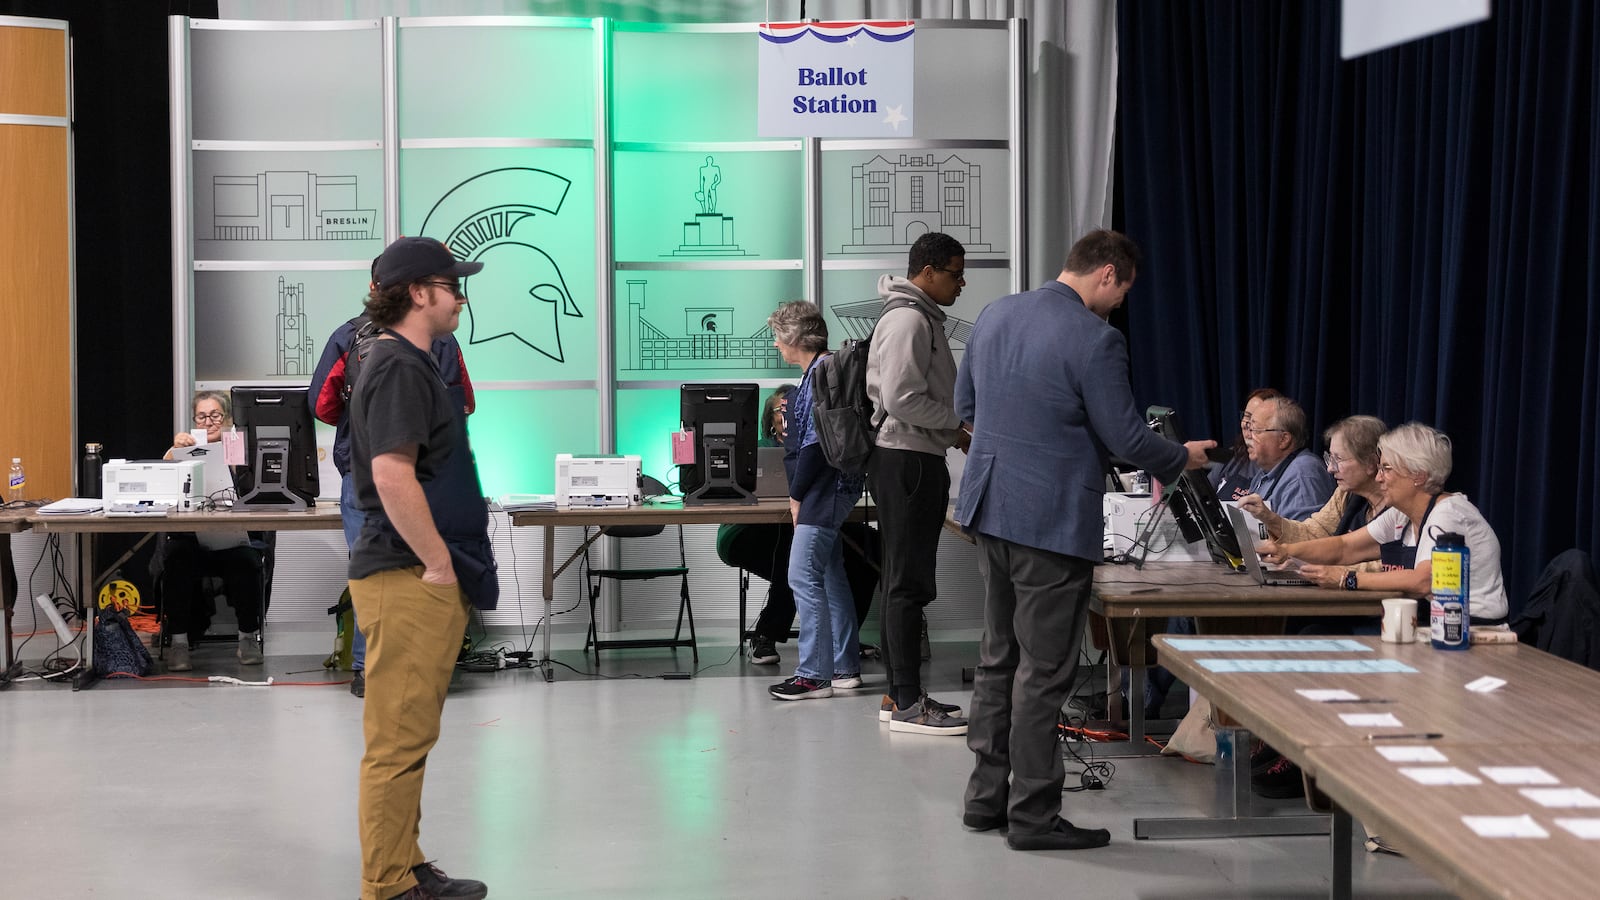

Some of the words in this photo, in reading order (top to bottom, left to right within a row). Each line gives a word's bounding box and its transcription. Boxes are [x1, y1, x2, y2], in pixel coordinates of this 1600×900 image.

[798, 67, 868, 86] Ballot
[793, 94, 877, 113] Station
[326, 217, 368, 225] BRESLIN
